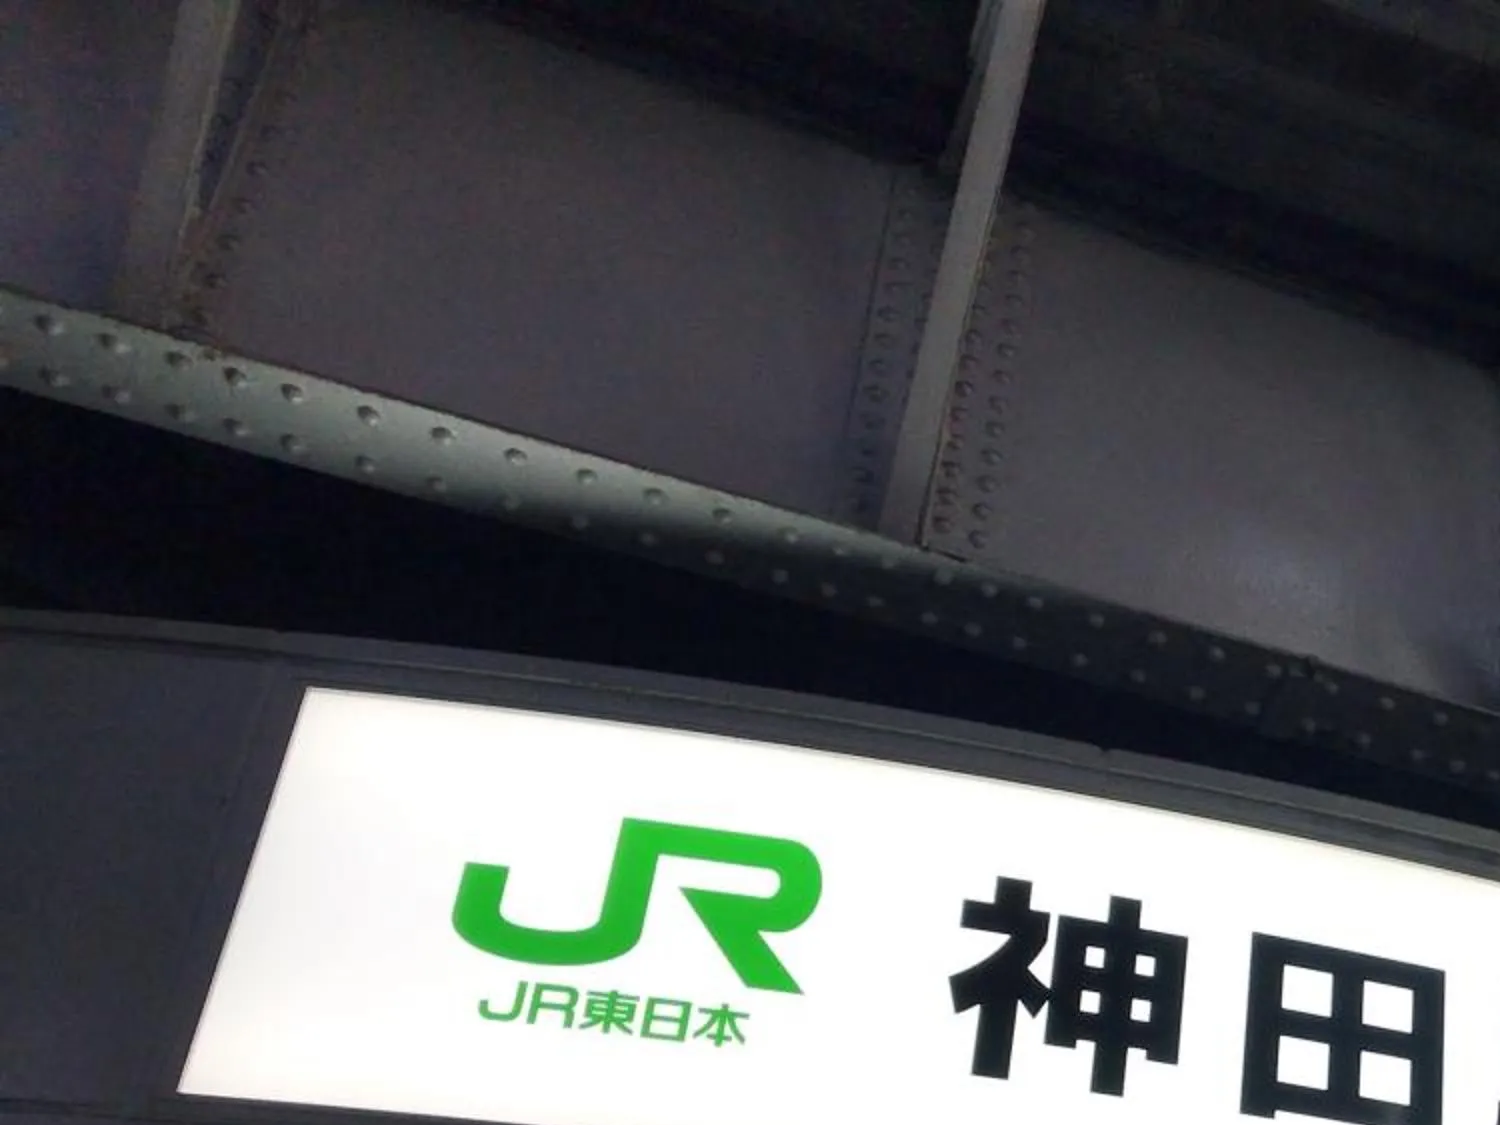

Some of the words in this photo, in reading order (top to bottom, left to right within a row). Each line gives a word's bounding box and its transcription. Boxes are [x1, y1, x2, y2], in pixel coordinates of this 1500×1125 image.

[452, 817, 823, 995] JR
[478, 981, 751, 1047] JR東日本
